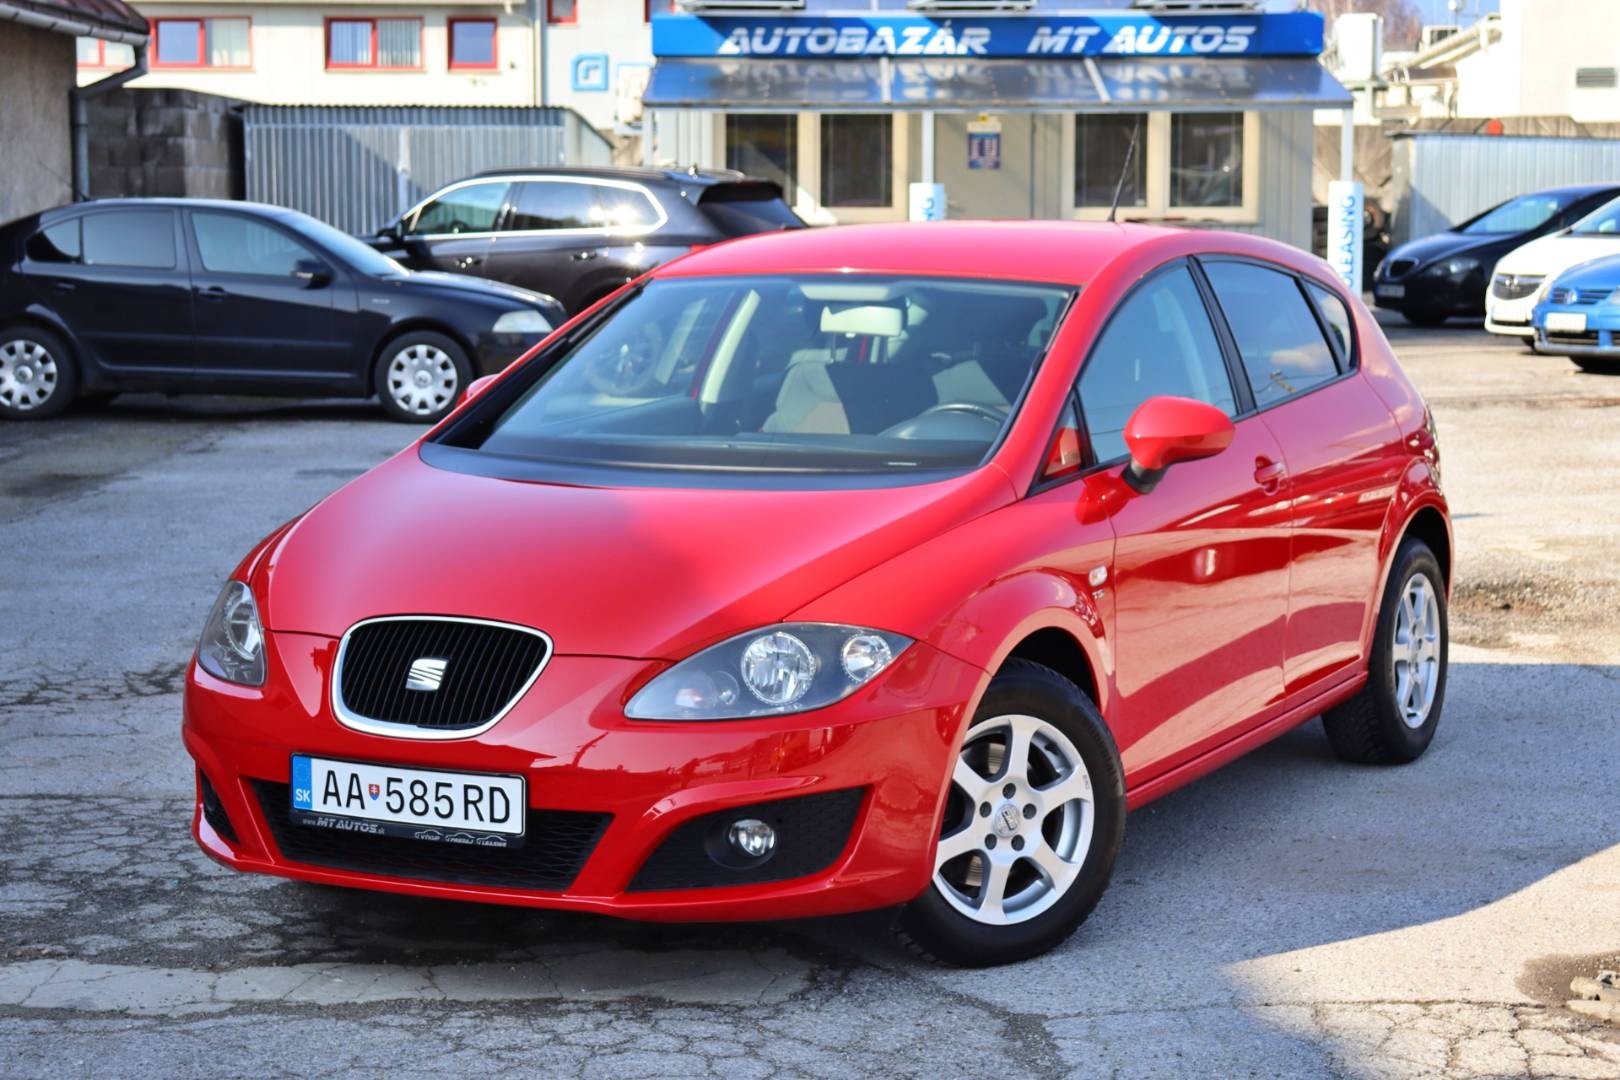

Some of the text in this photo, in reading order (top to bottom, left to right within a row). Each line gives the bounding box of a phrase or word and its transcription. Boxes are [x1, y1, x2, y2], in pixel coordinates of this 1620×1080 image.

[718, 20, 1257, 55] AUTOBAZÁR MT AUTOS
[295, 788, 311, 803] SK
[323, 770, 511, 824] AA 585RD
